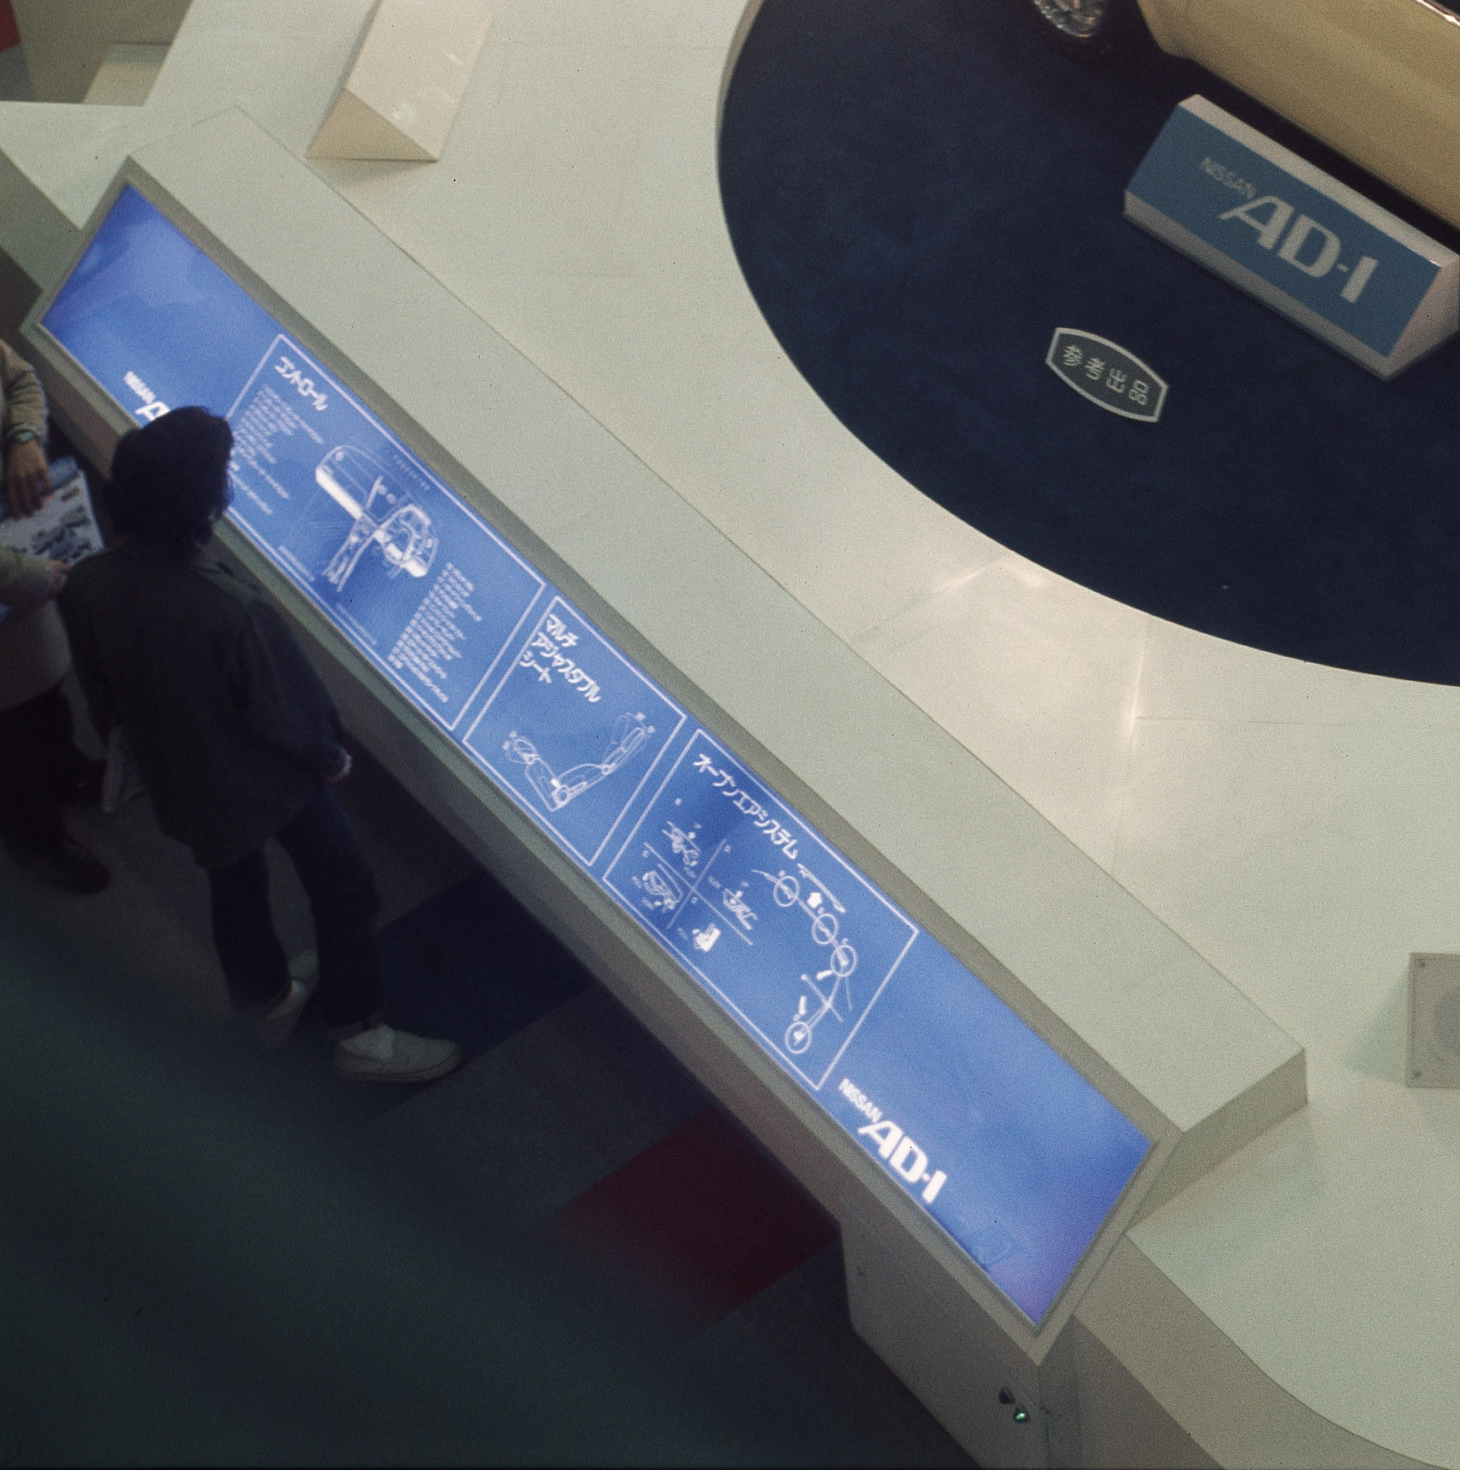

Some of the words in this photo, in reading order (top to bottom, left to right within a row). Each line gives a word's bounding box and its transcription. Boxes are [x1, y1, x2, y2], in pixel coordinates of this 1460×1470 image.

[1202, 157, 1257, 199] NISSAN
[274, 356, 328, 411] コントロール
[1063, 345, 1149, 406] 参考出品
[546, 613, 579, 648] マルチ
[519, 650, 552, 684] シート
[531, 631, 601, 703] アジャスタブル
[693, 753, 799, 859] オープンエアシステム
[838, 1078, 883, 1123] NISSAN
